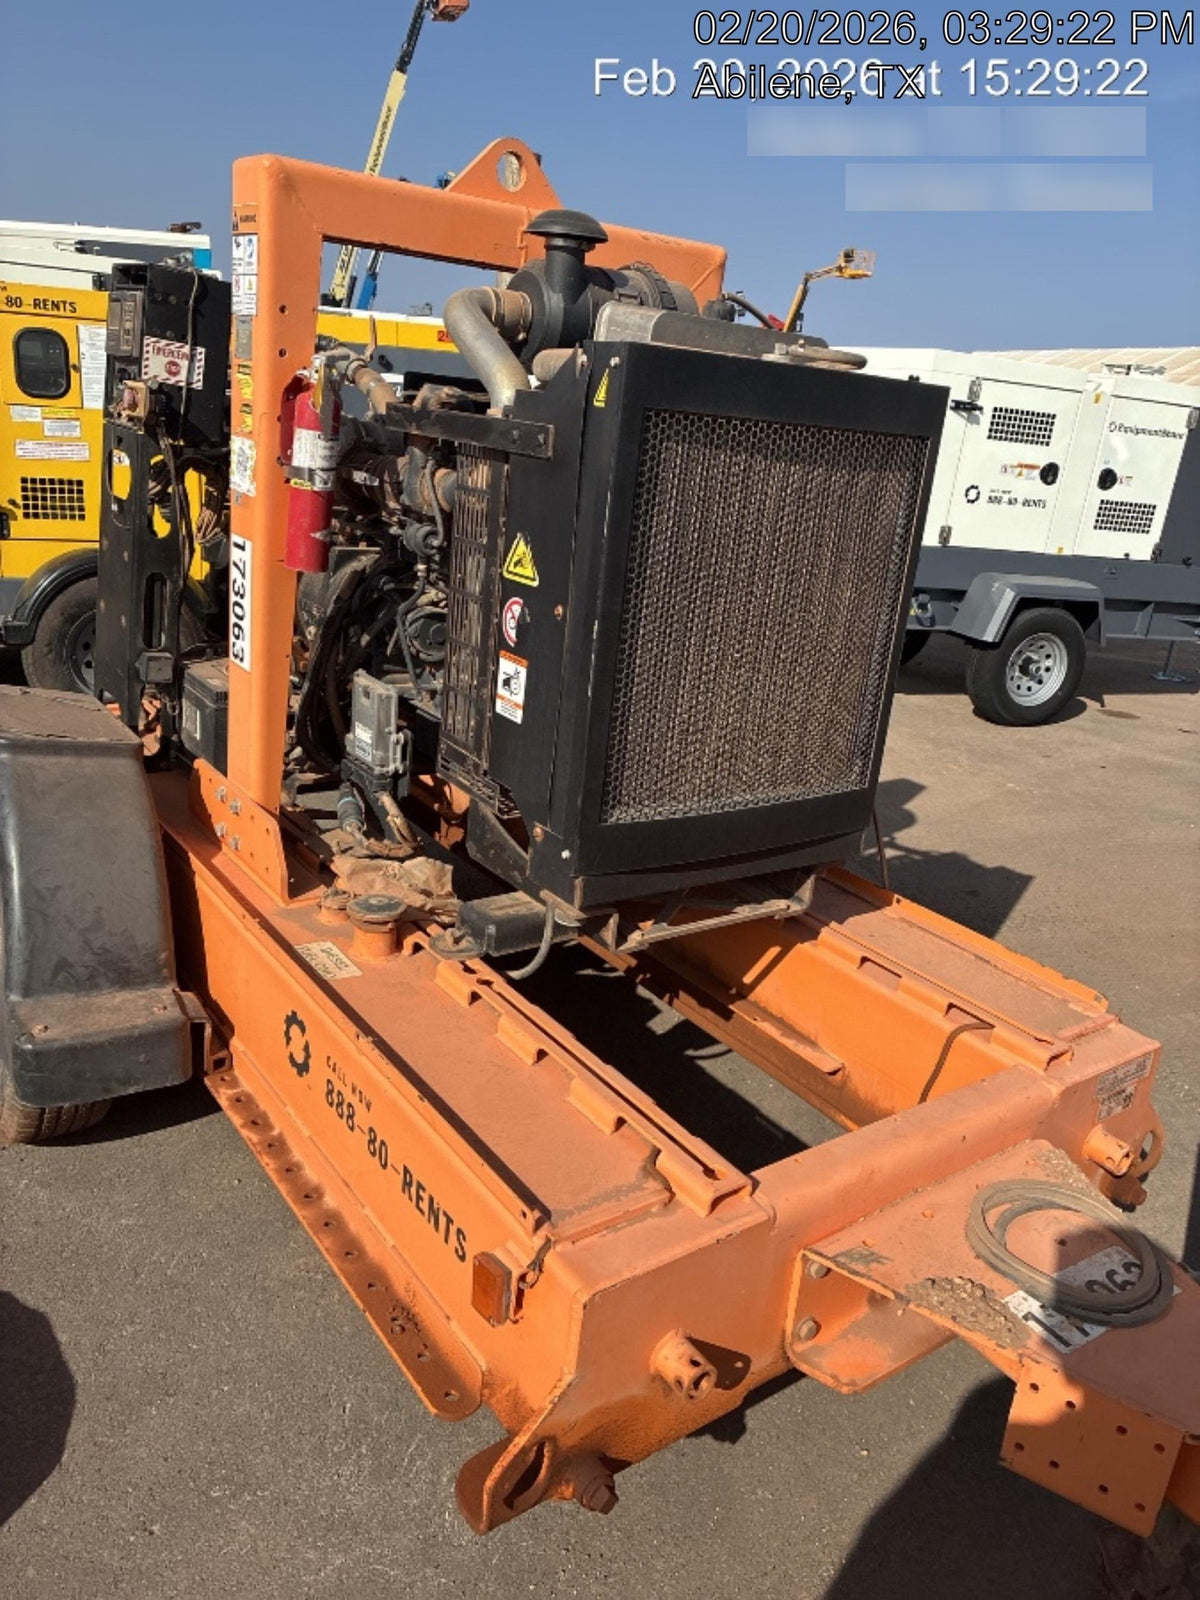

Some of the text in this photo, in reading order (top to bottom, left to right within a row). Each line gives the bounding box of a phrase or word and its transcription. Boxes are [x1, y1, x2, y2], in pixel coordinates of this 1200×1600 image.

[232, 540, 247, 663] 173063
[326, 1055, 348, 1087] CALL
[325, 1078, 467, 1263] 888-80-RENTS
